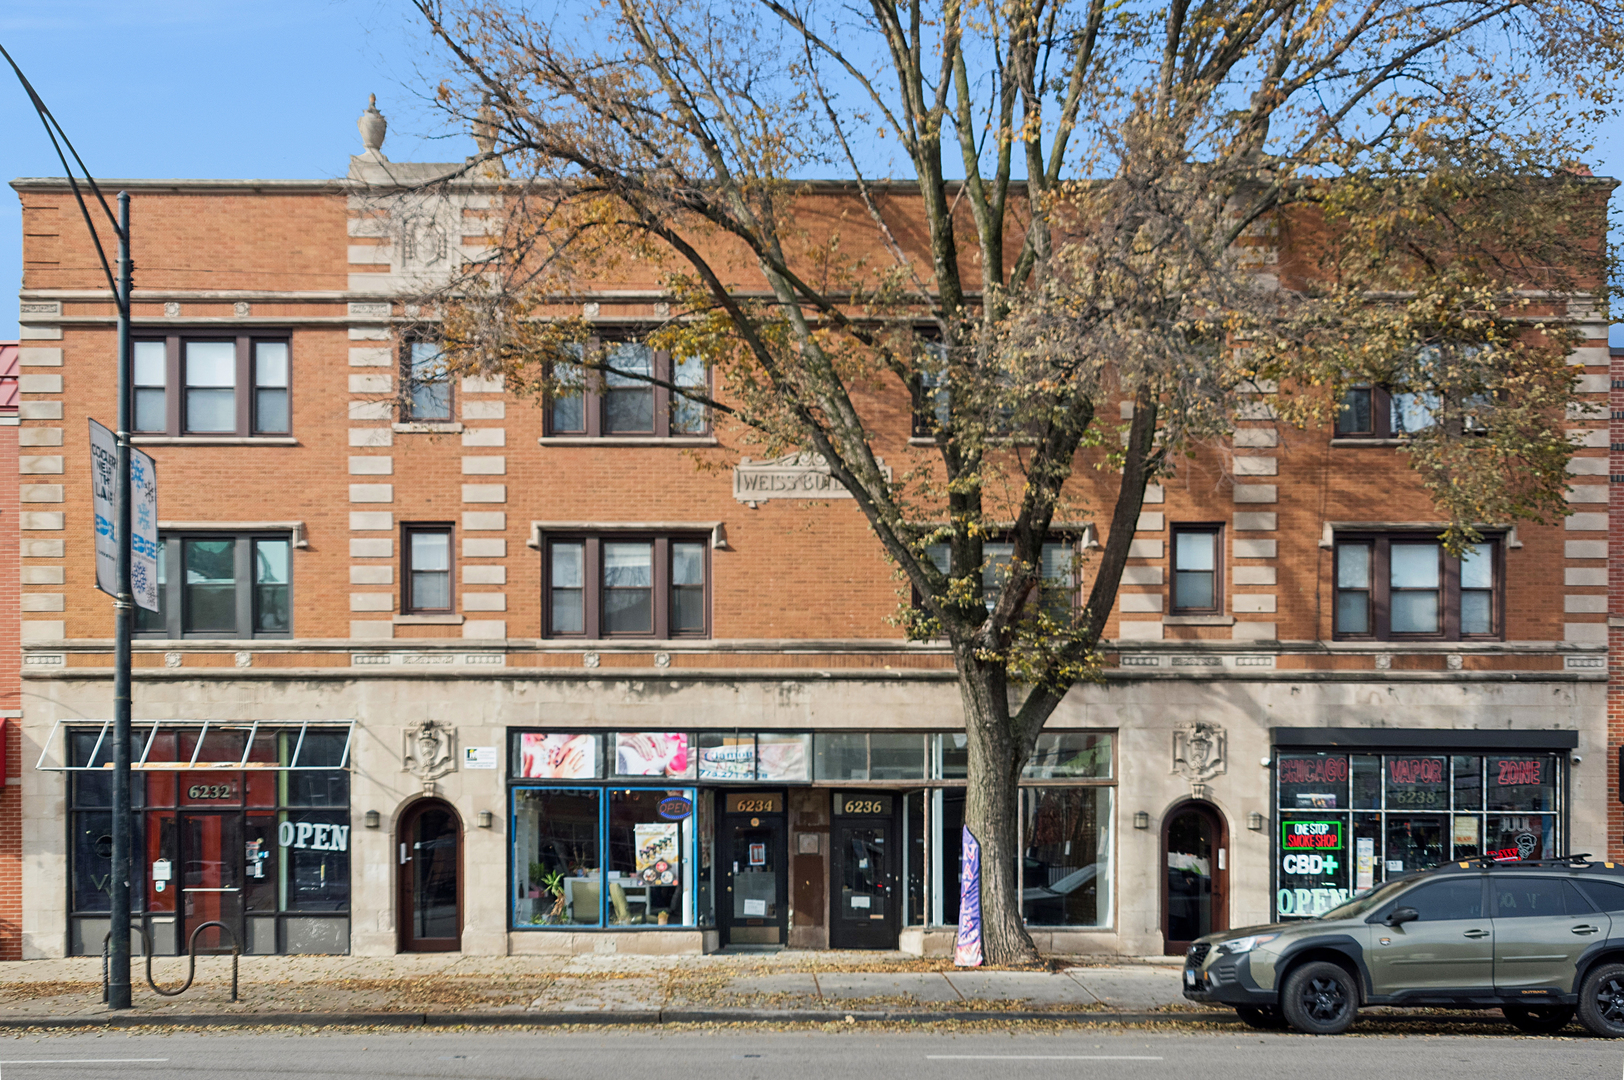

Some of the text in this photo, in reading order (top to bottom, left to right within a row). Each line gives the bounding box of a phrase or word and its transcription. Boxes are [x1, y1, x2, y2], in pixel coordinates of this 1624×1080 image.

[743, 474, 797, 491] WEISS
[131, 532, 156, 560] EDGE
[1278, 757, 1541, 785] CHICAGO VAPOR ZONE
[188, 784, 231, 799] 6232
[1396, 791, 1436, 804] 6238
[659, 802, 690, 814] OPEN
[737, 799, 773, 812] 6234
[845, 800, 882, 813] 6236
[1294, 823, 1329, 835] ONE STOP
[1501, 816, 1532, 832] JUUL
[278, 821, 350, 851] OPEN
[1287, 834, 1337, 847] SMOKE SHOP
[1277, 888, 1348, 914] OPEN
